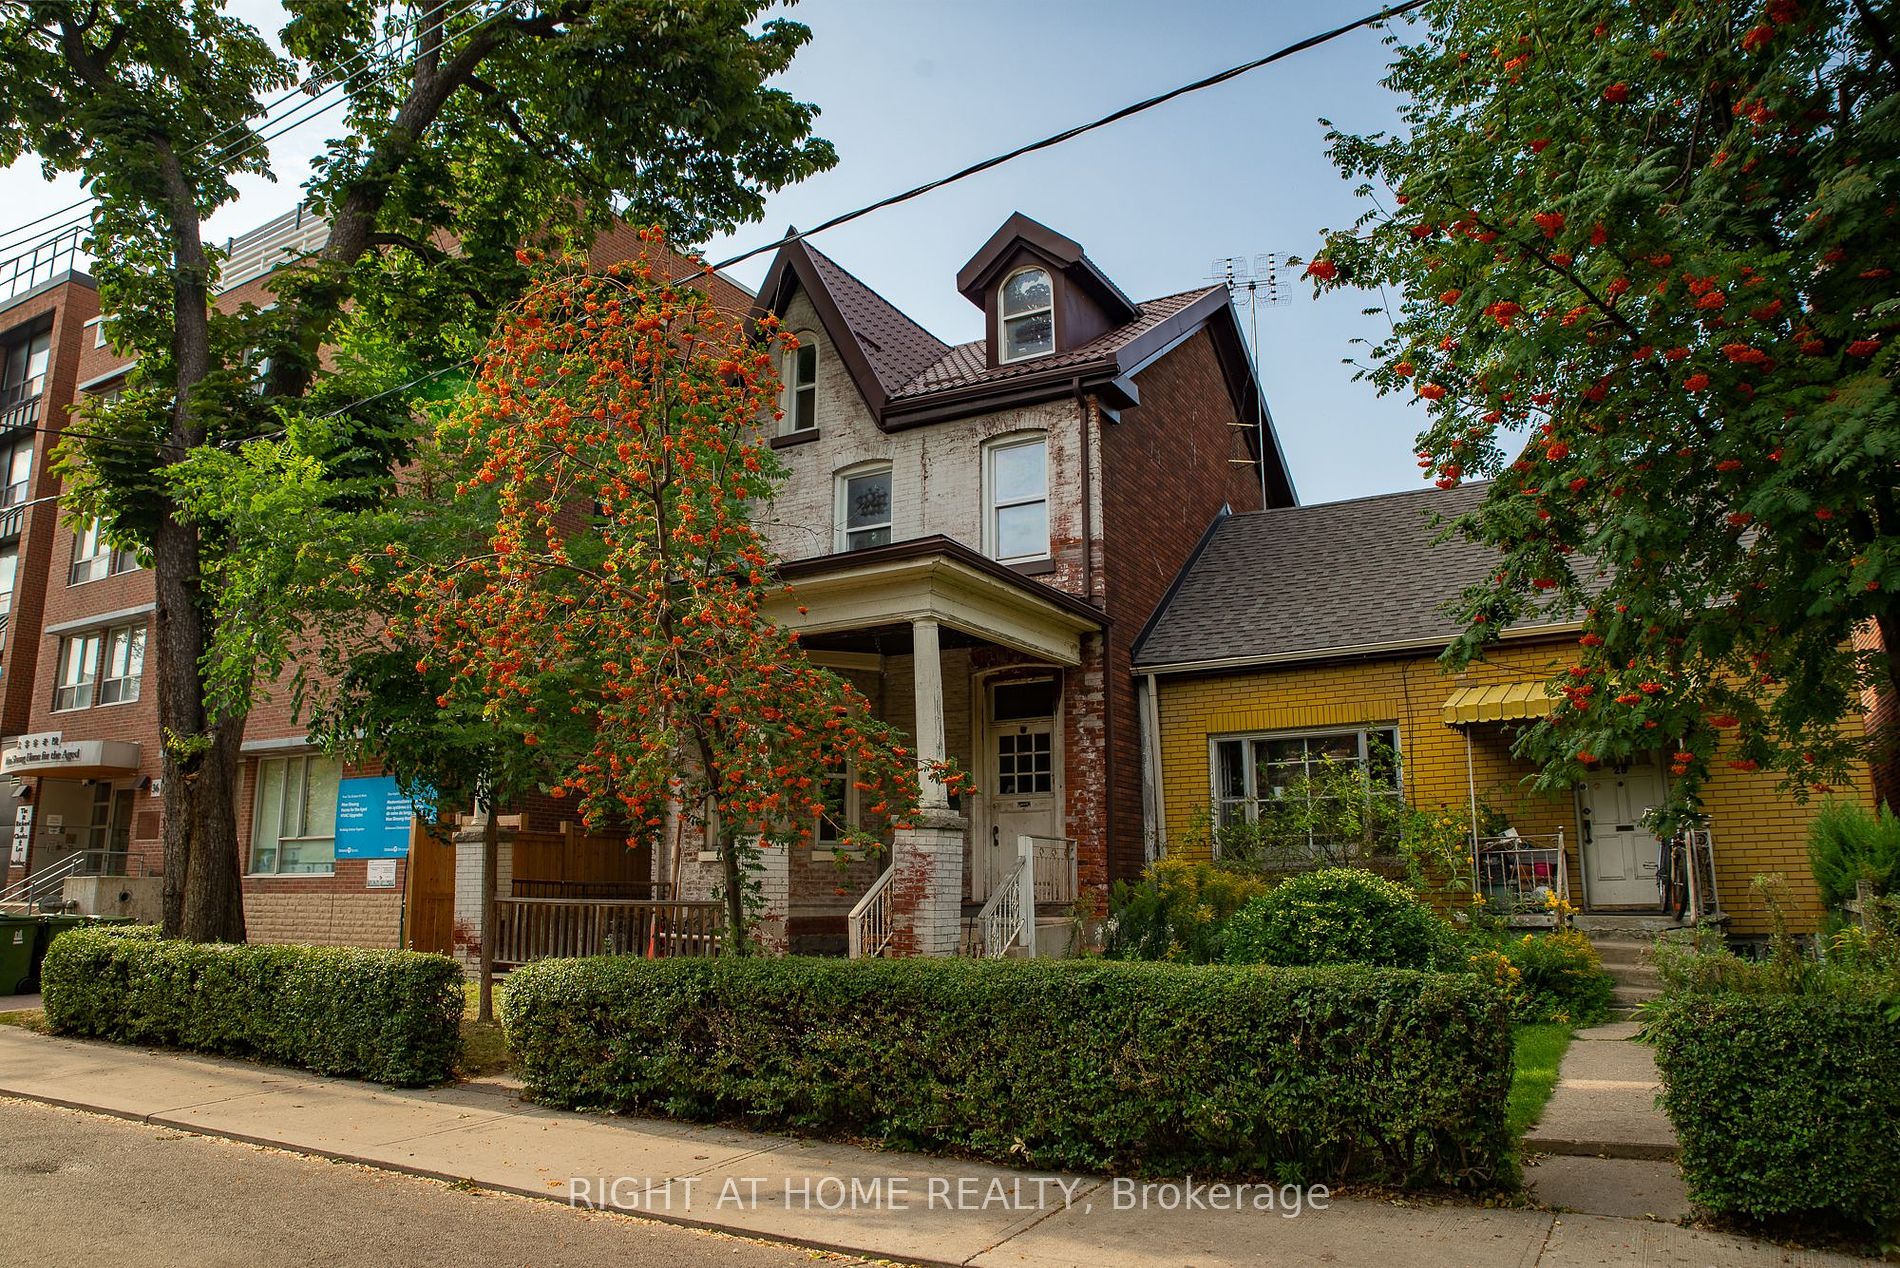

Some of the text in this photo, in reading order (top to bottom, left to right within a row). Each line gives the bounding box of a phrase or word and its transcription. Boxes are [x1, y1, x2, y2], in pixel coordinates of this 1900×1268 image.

[42, 751, 50, 760] for
[51, 750, 61, 759] the
[62, 748, 80, 761] Aged
